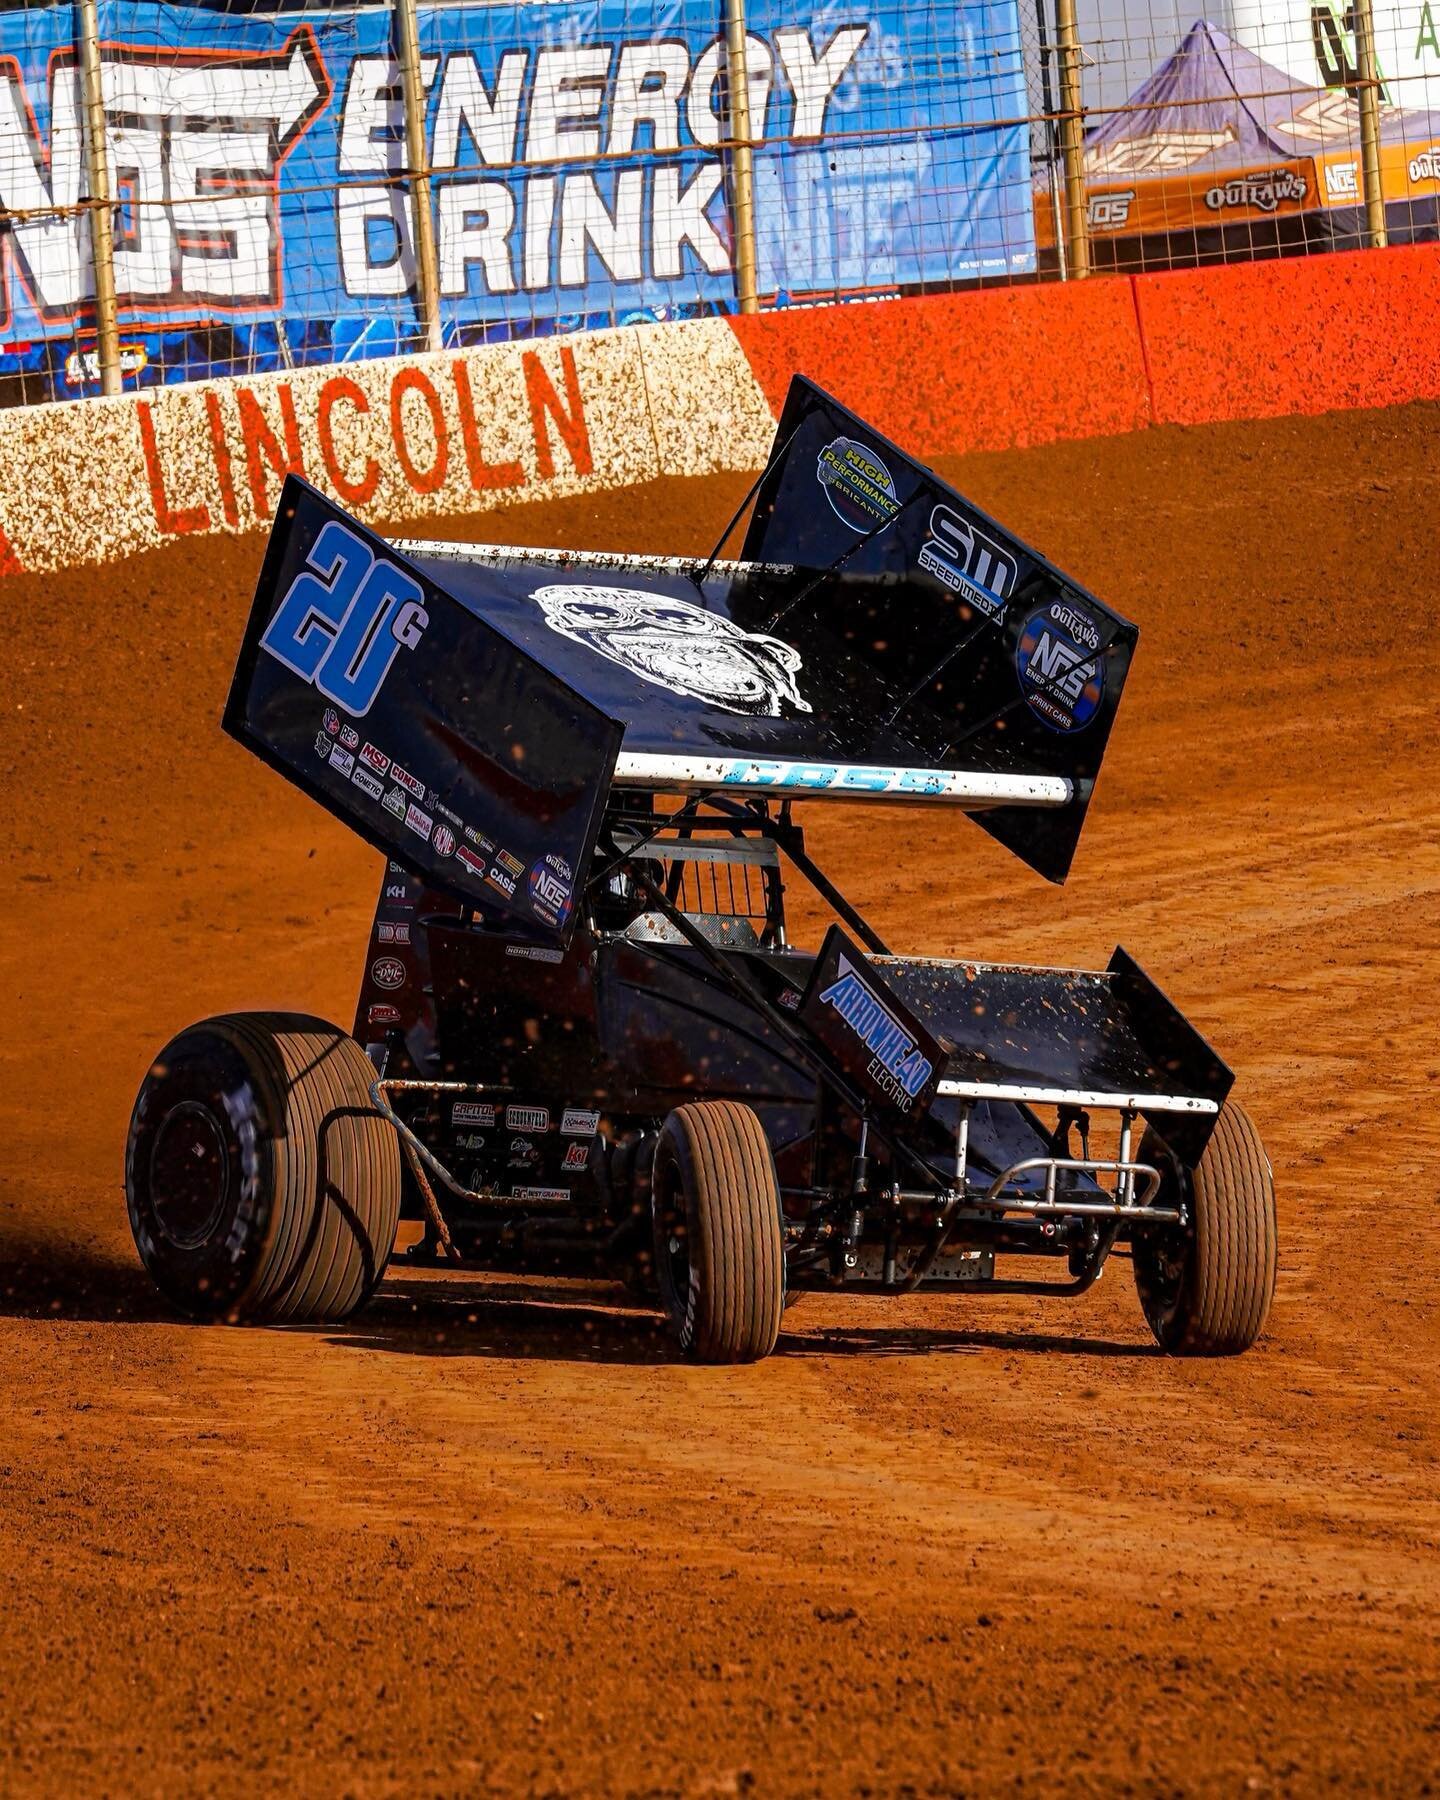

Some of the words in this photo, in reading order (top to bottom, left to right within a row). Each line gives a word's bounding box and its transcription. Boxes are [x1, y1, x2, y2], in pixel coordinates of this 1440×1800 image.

[336, 24, 870, 175] ENERGY
[1206, 174, 1308, 211] OUTLAWS
[1325, 162, 1358, 193] NOS
[336, 161, 733, 300] DRINK
[137, 346, 594, 534] LINCOLN
[823, 451, 899, 514] PERFORMANCE
[845, 449, 890, 488] HIGH
[821, 470, 886, 523] LUBRICANTS
[919, 552, 961, 591] SPEED
[1050, 603, 1099, 650] OUTLAWS
[1030, 631, 1096, 699] NOS
[1025, 667, 1053, 694] ENERY
[1053, 688, 1076, 709] DRINK
[1052, 709, 1073, 729] CARS
[362, 743, 389, 769] MSD
[354, 772, 381, 796] COMETIC
[392, 766, 417, 788] COMP
[386, 885, 406, 898] KH
[490, 867, 517, 894] CASE
[535, 869, 570, 909] NOS
[819, 973, 933, 1098] ARROWHEAD
[866, 1057, 913, 1114] ELECTRIC
[453, 1104, 496, 1115] CAPITOL
